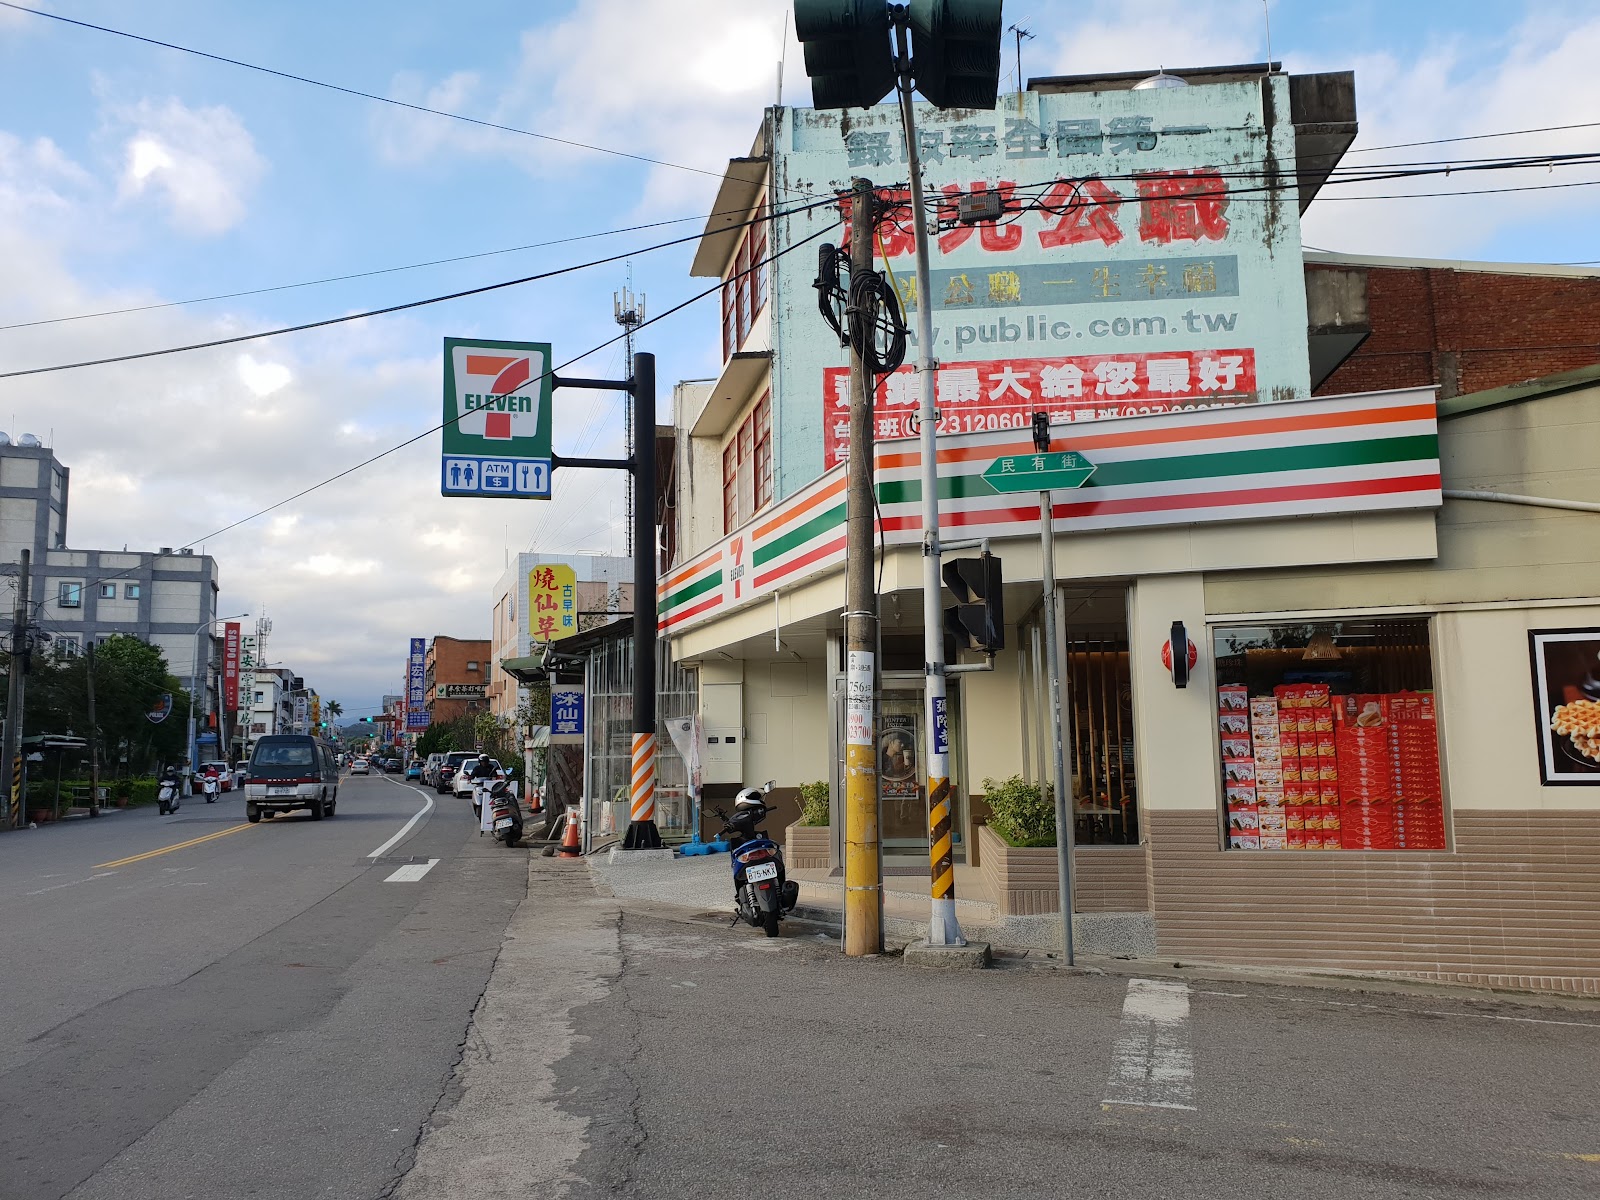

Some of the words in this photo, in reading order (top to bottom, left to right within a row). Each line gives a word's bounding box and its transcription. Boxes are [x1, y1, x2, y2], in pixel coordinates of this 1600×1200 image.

[875, 308, 1240, 354] w.public.com.tw
[485, 464, 510, 474] ATM
[1001, 454, 1077, 474] 民有街
[533, 567, 560, 640] 燒仙草
[562, 584, 574, 628] 古早味
[227, 629, 238, 659] SAMPO
